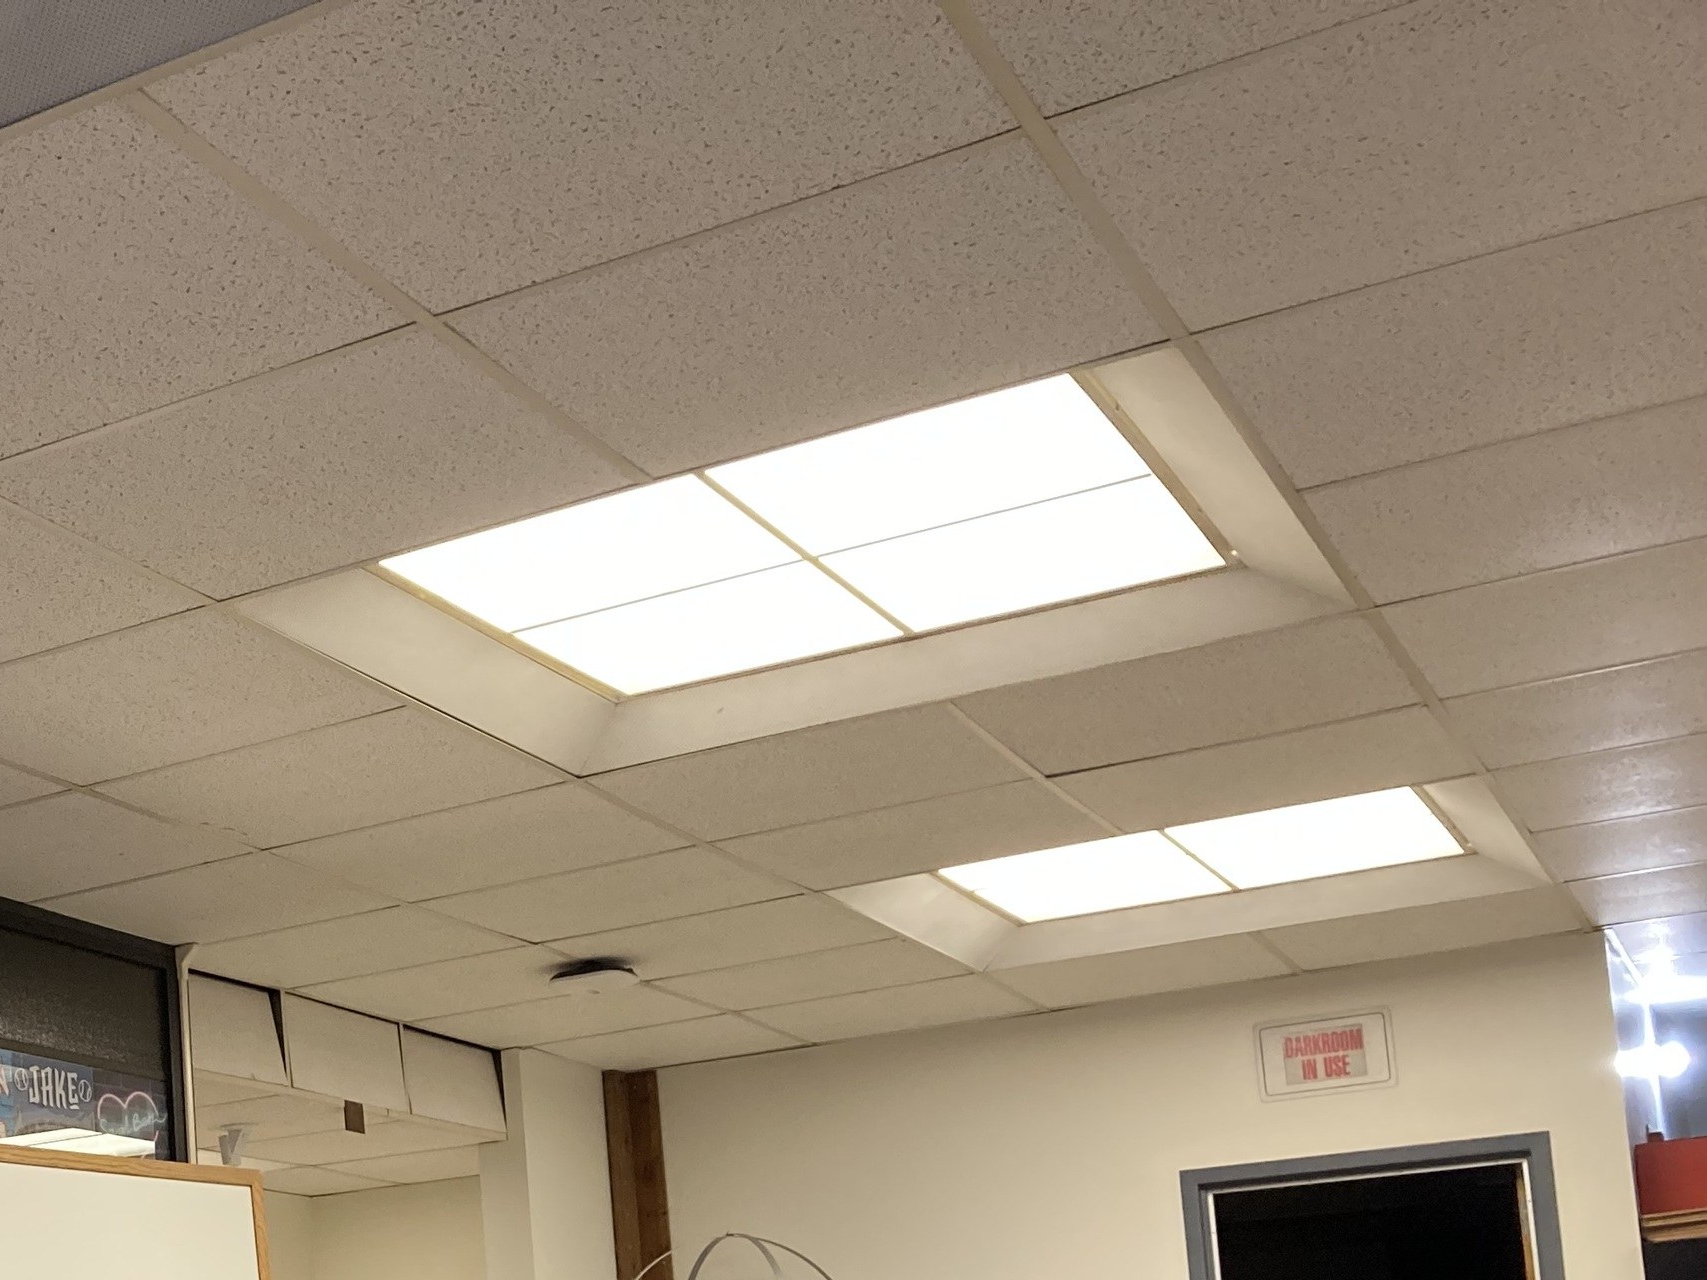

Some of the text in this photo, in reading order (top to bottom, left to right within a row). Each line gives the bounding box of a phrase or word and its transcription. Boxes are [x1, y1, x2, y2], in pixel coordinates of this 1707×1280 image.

[1284, 1028, 1364, 1058] DARKROOM
[1301, 1054, 1351, 1080] IN USE
[29, 1065, 80, 1110] JAKE
